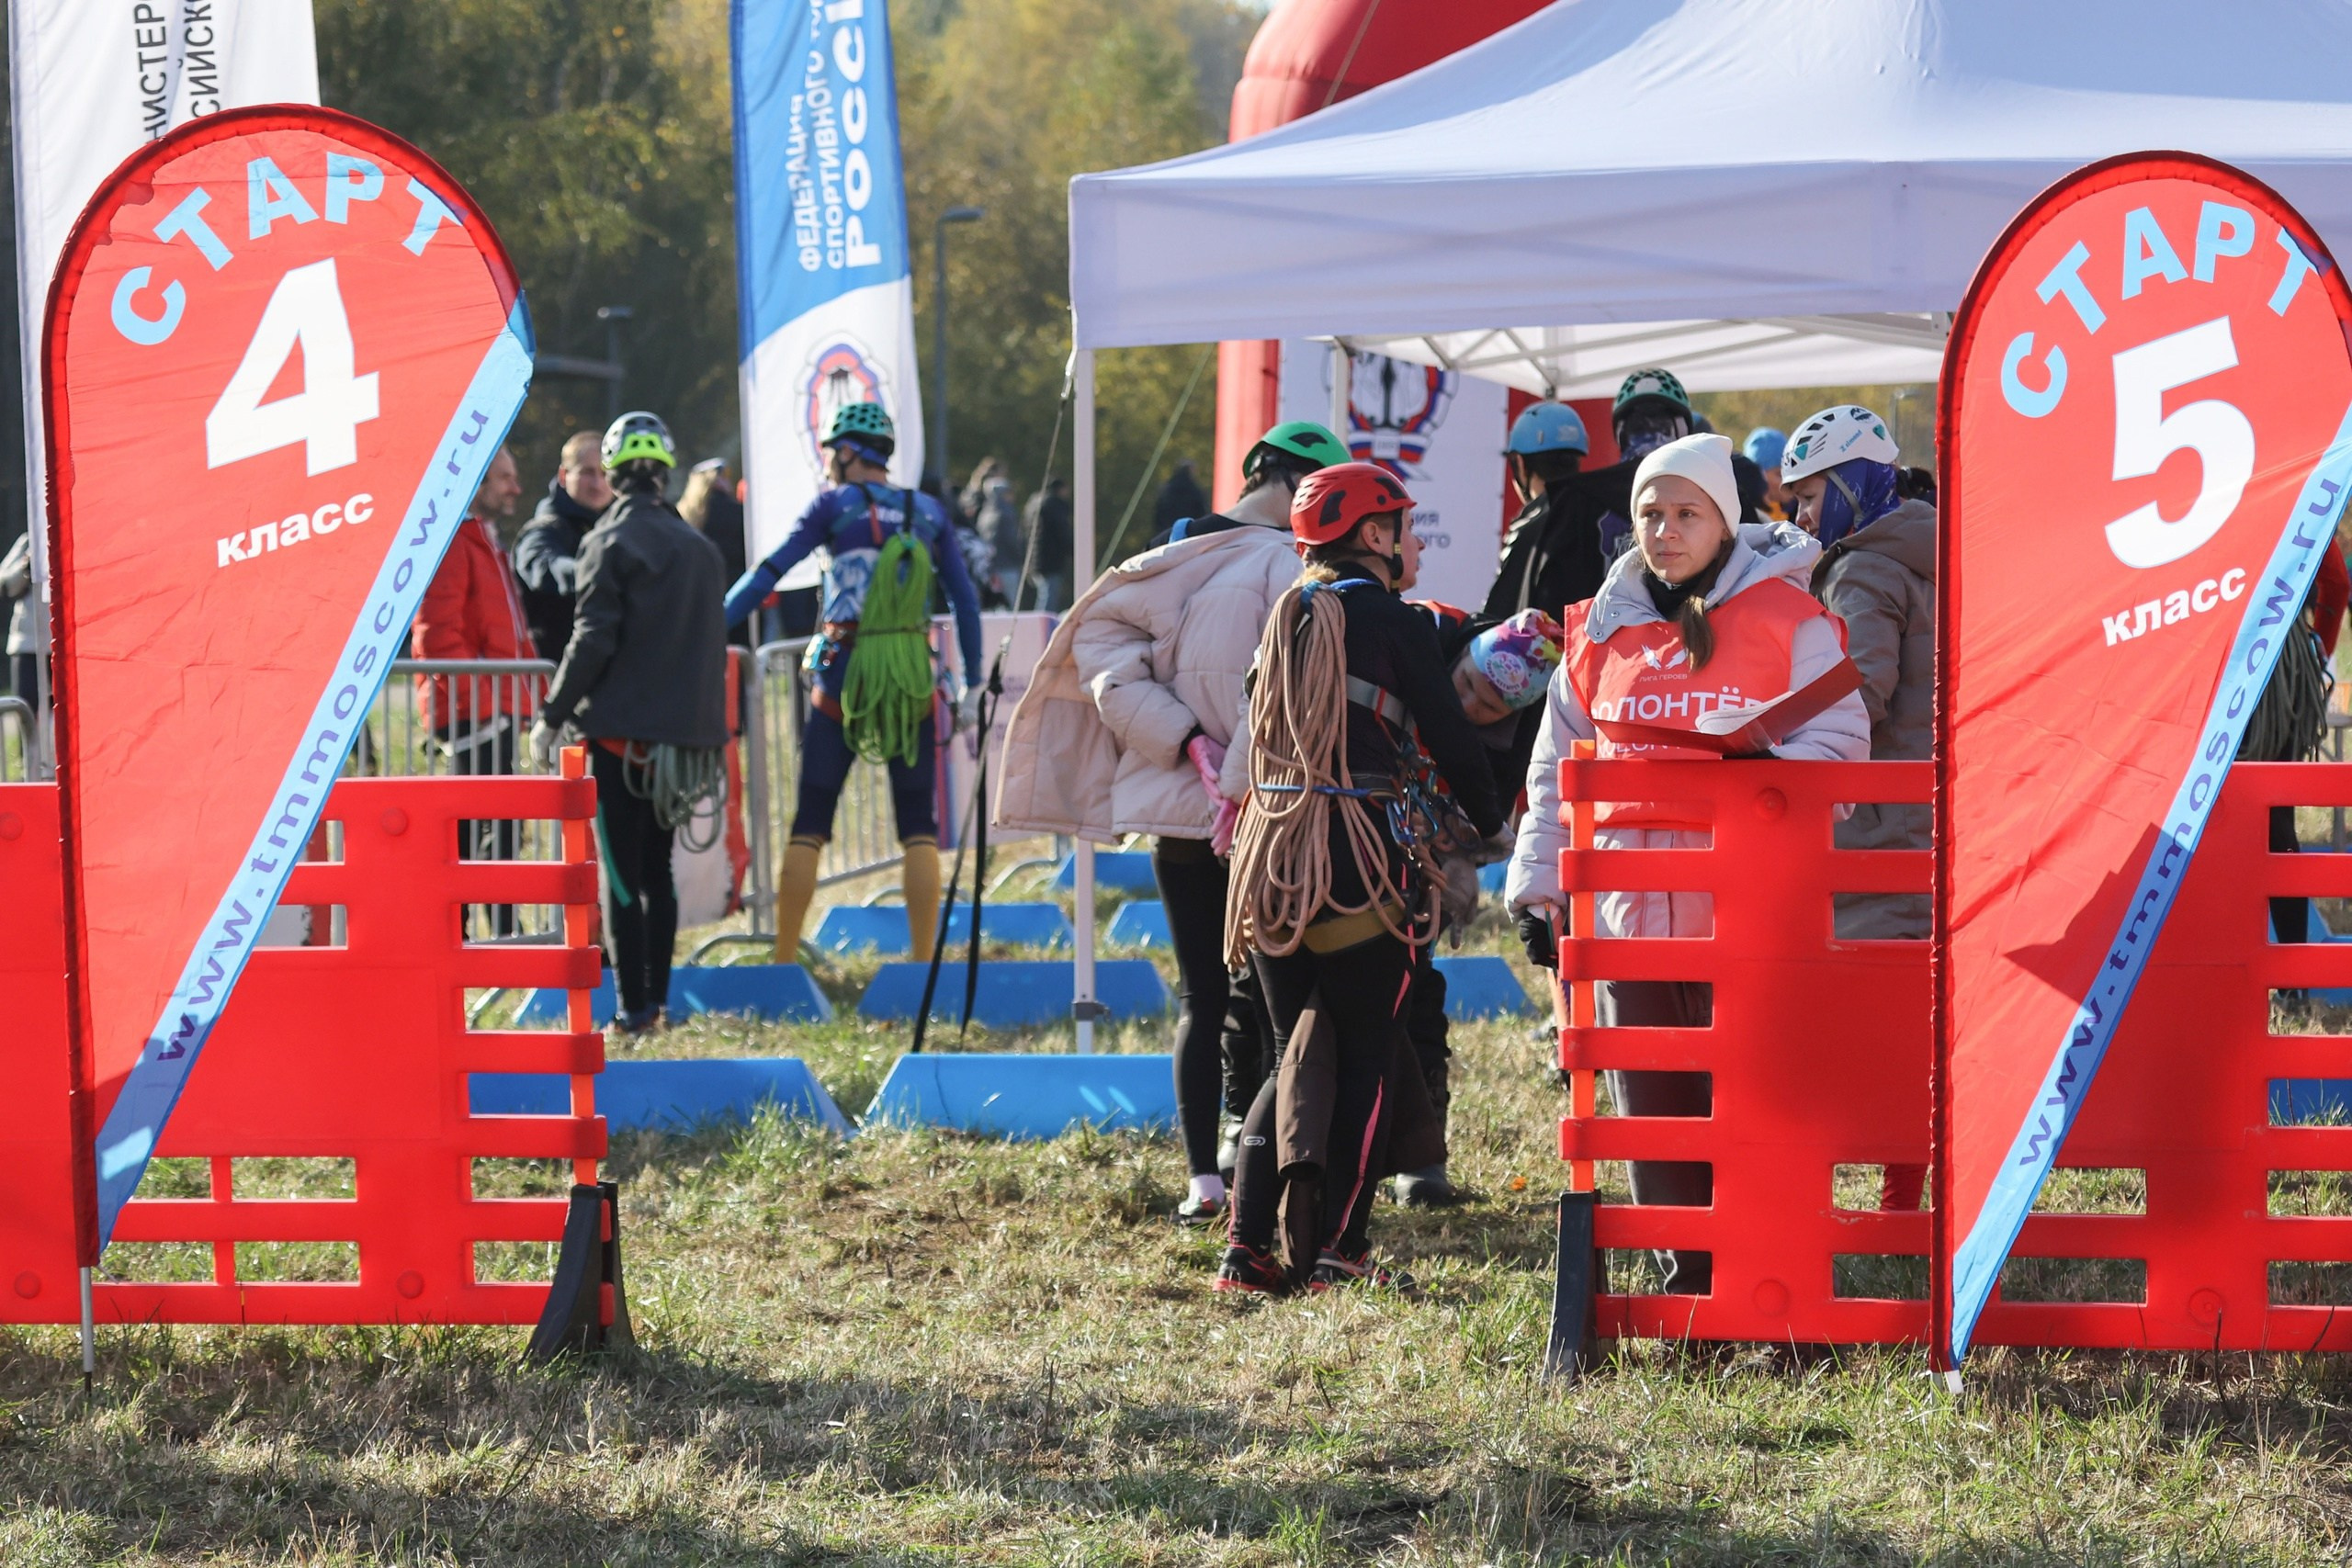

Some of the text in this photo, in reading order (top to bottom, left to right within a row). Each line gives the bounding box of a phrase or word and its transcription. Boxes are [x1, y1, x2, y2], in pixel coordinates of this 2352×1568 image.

[133, 0, 167, 142] НИСТЕР
[176, 0, 220, 118] СИЙСК
[111, 152, 467, 345] СТАРТ
[2001, 200, 2334, 419] СТАРТ
[206, 257, 380, 477] 4
[2105, 315, 2256, 569] 5
[217, 492, 374, 568] класс
[2102, 567, 2246, 647] класс
[156, 409, 489, 1064] www.tmmoscow.ru
[2019, 479, 2341, 1168] www.tmmoscow.ru
